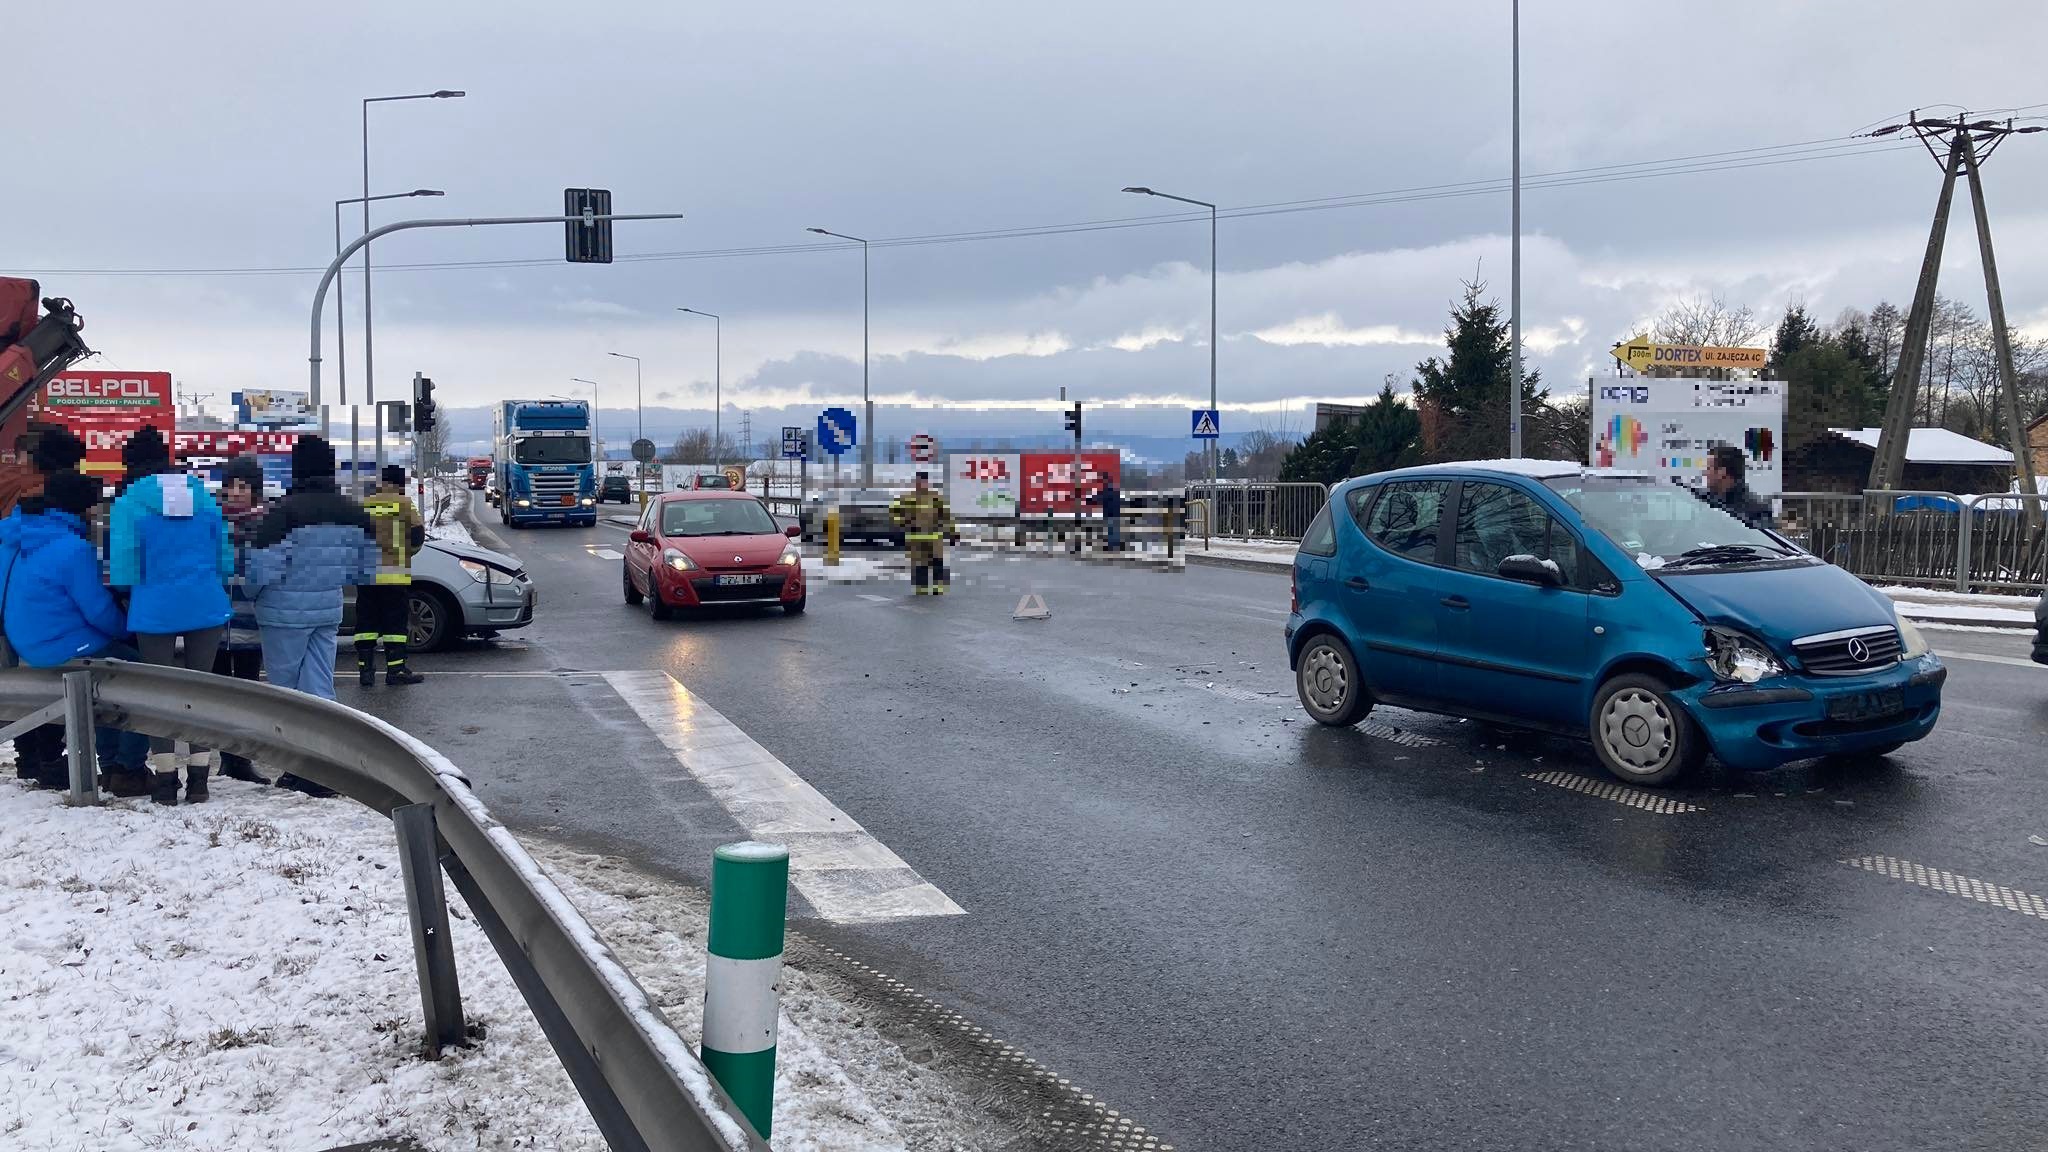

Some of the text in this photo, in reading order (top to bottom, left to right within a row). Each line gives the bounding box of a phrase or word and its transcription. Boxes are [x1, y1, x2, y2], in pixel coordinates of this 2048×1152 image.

[1632, 350, 1651, 358] 300m
[1655, 347, 1702, 362] DORTEX
[1717, 352, 1749, 363] ZAJĘCZA
[1751, 353, 1761, 362] 4C
[47, 378, 160, 397] BEL-POL
